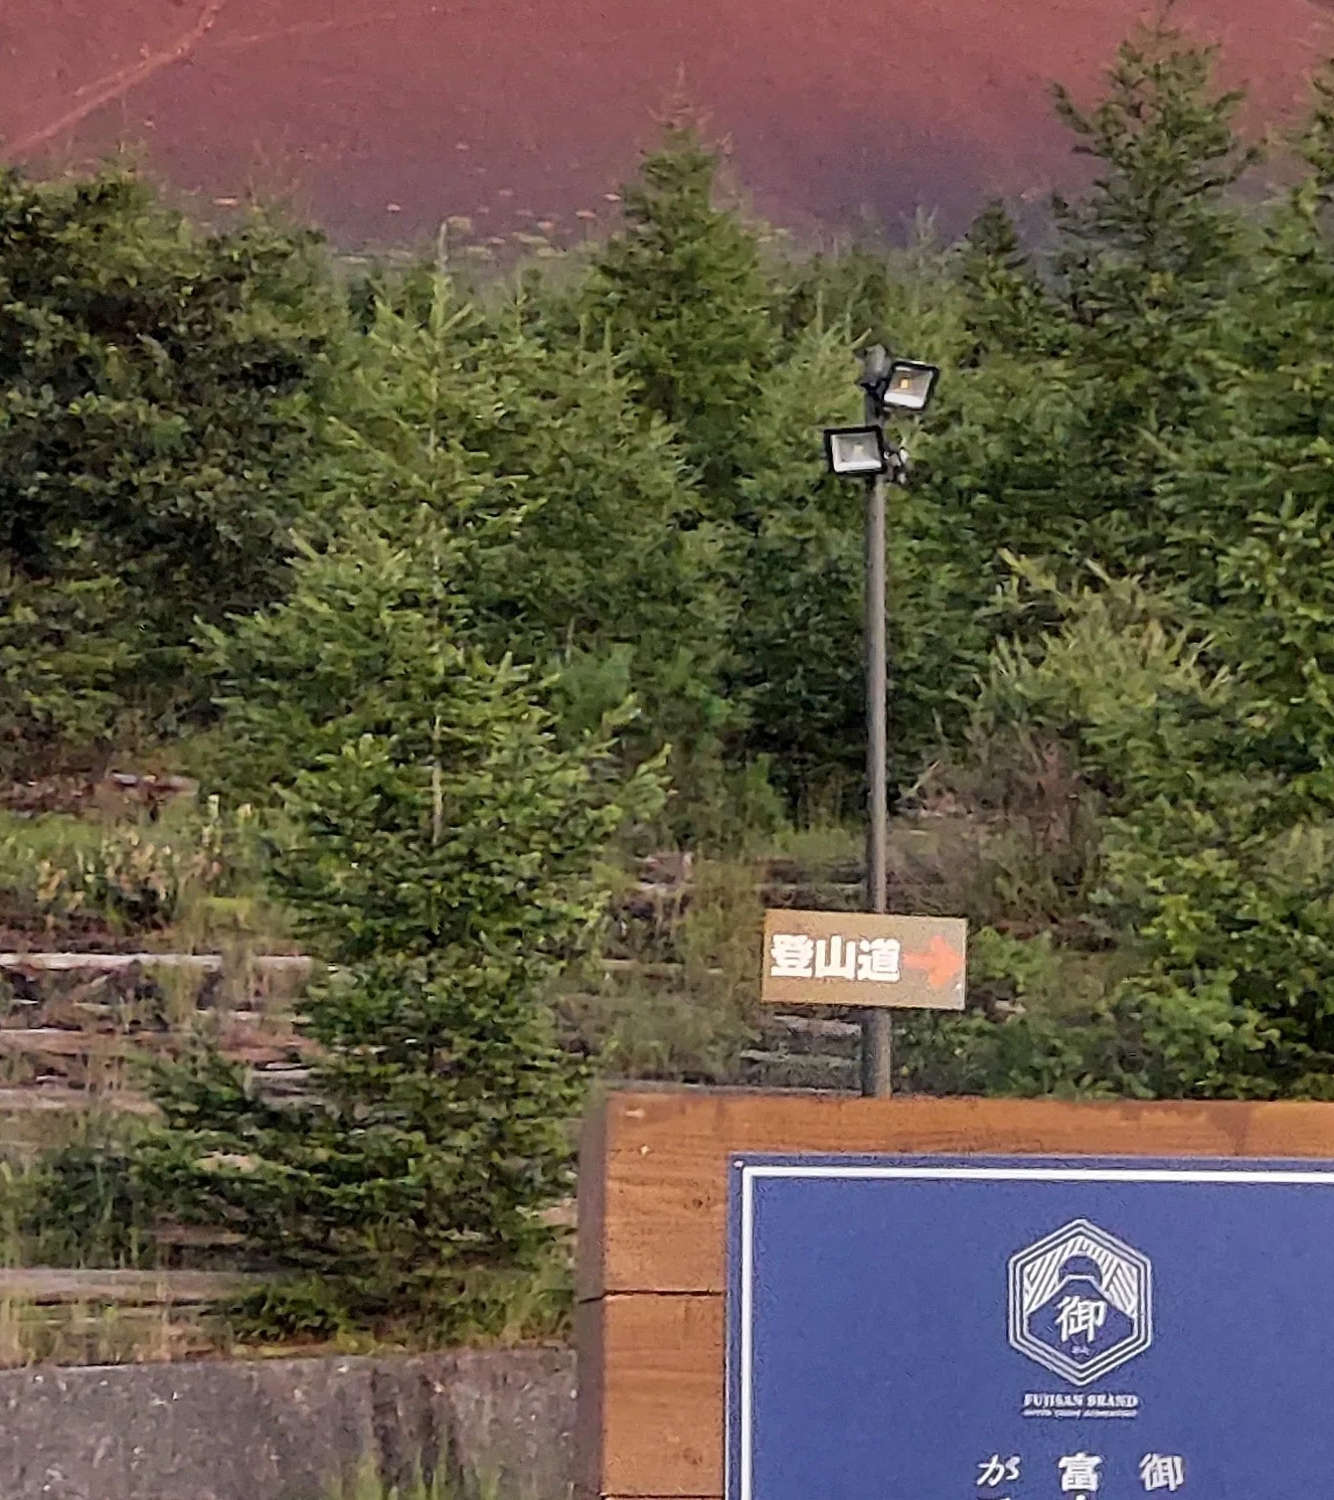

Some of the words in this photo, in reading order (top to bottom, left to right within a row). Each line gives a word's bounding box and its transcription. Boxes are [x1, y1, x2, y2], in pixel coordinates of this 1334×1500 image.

[770, 933, 900, 982] 登山道
[1054, 1295, 1107, 1342] 御
[1087, 1393, 1139, 1407] BRAND
[976, 1453, 1021, 1500] が
[1058, 1452, 1103, 1500] 富
